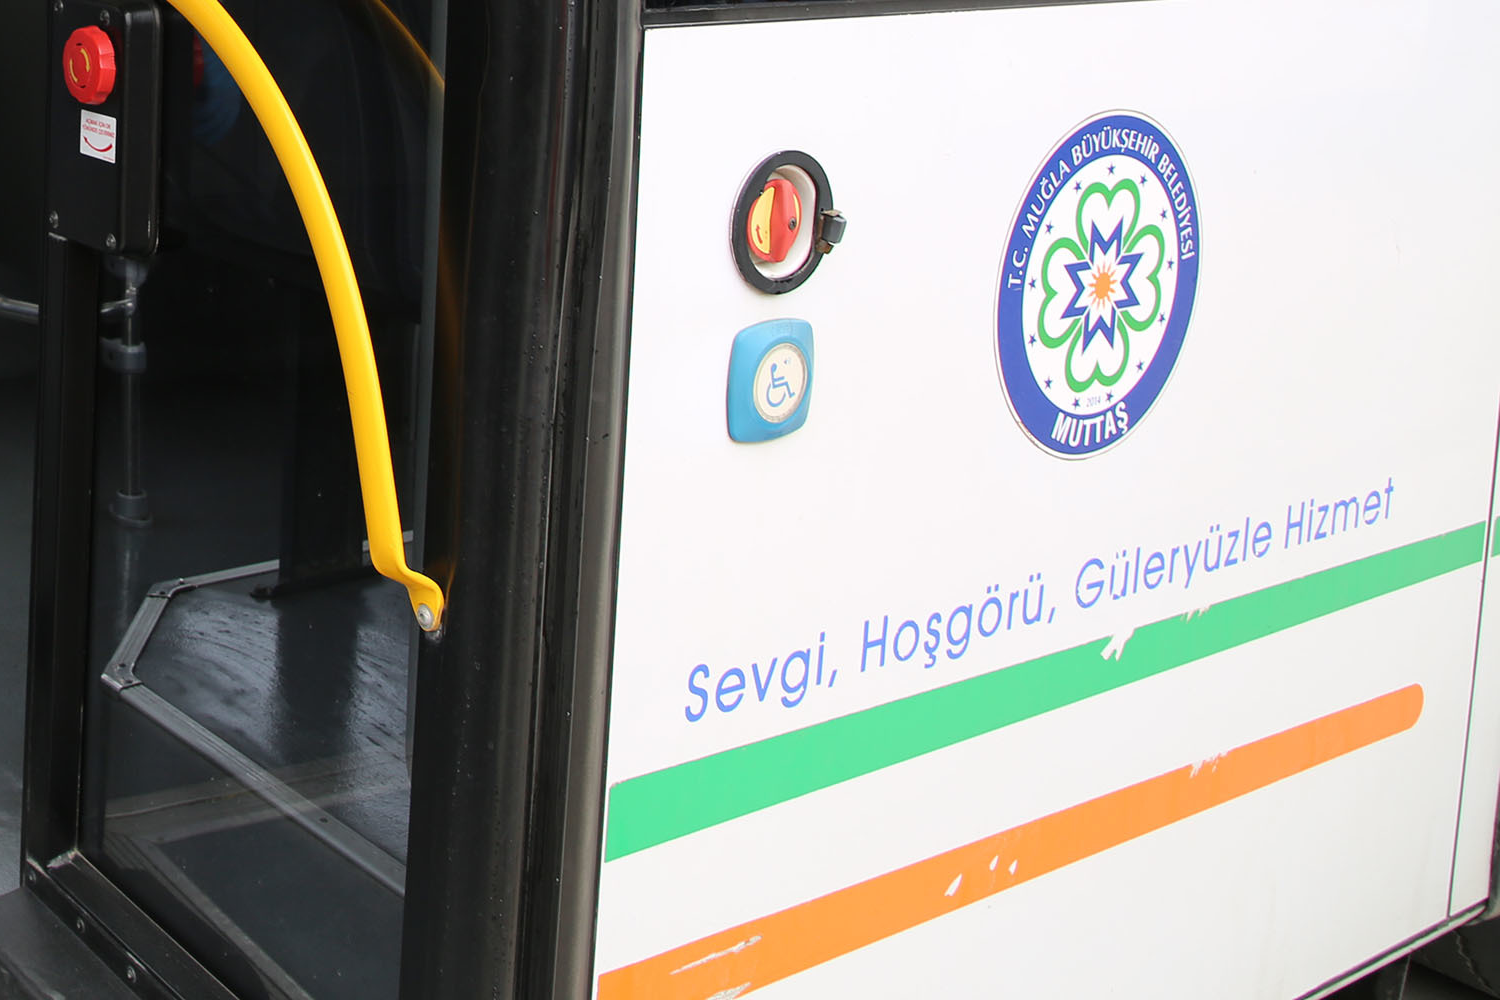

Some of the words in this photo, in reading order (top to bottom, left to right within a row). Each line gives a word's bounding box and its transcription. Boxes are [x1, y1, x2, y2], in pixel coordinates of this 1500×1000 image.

[1008, 247, 1029, 288] T.C.
[1021, 159, 1071, 240] MUĞLA
[1070, 125, 1160, 166] BÜYÜKŞEHİR
[1156, 152, 1195, 261] BELEDİYESİ
[1050, 400, 1129, 448] MUTTAŞ
[684, 630, 838, 723] Sevgi,
[860, 572, 1056, 674] Hoşgörü,
[1074, 515, 1273, 609] Güleryüzle
[1283, 476, 1394, 550] Hizmet
